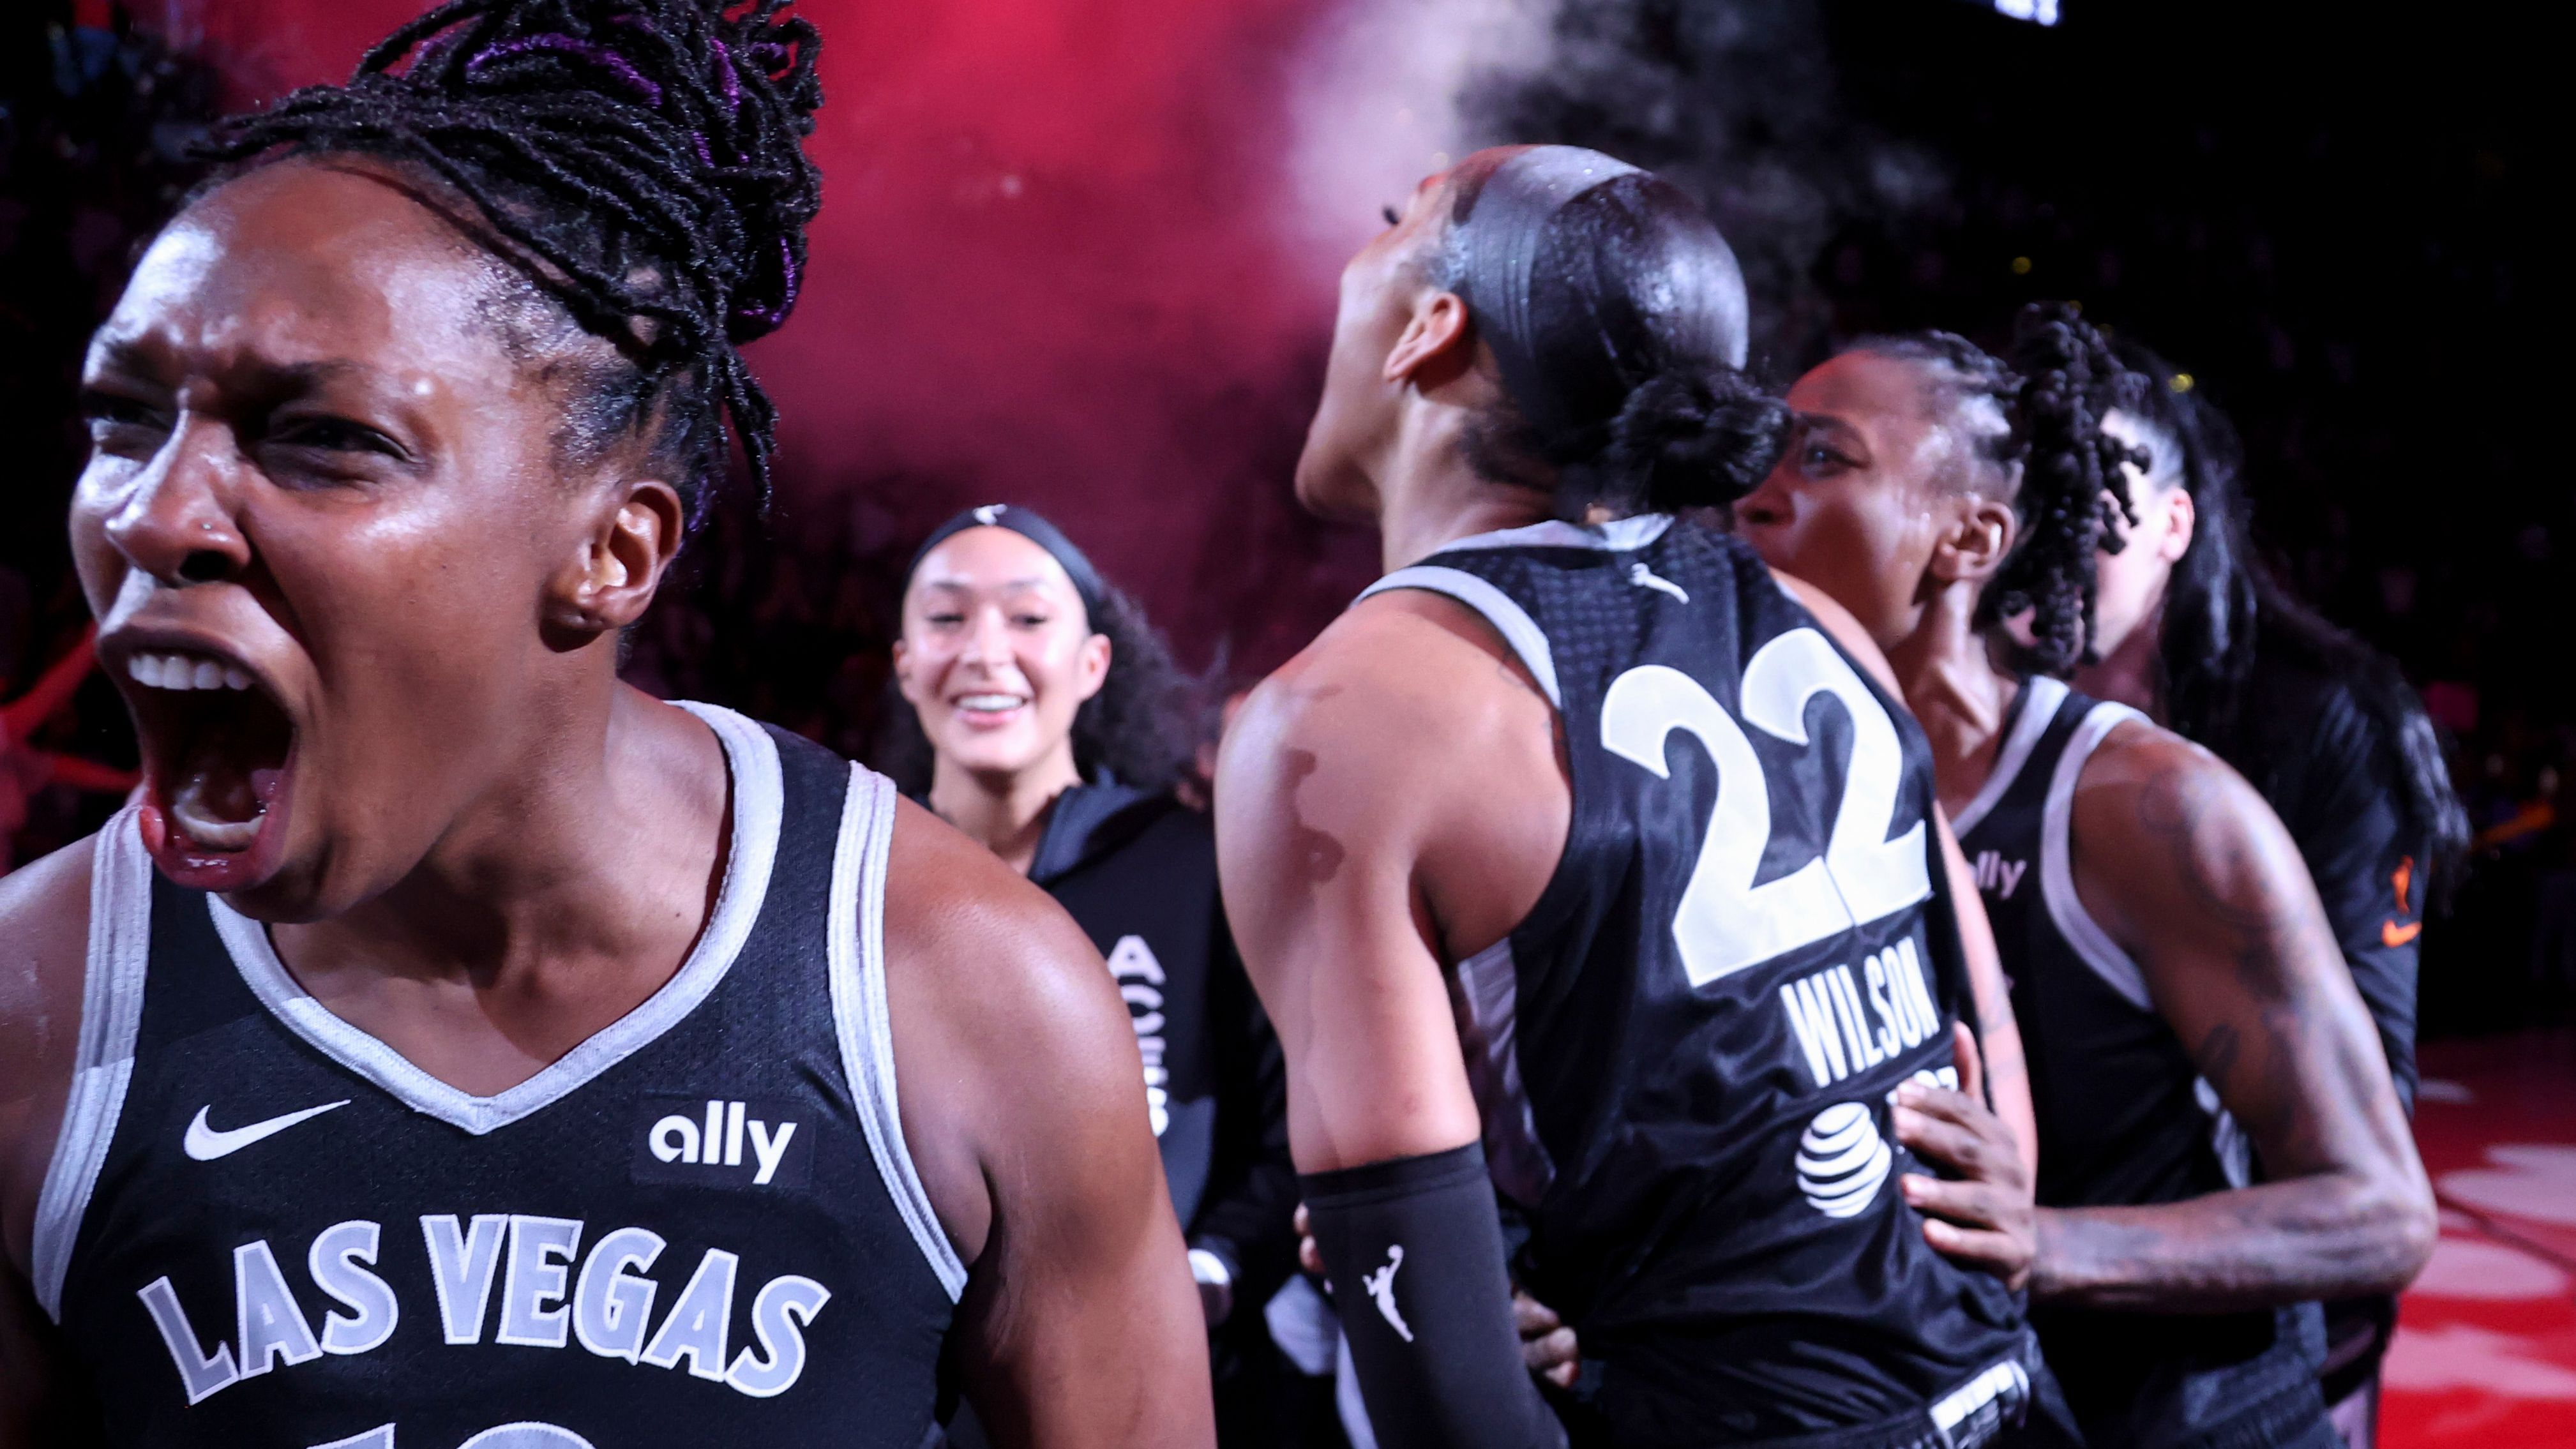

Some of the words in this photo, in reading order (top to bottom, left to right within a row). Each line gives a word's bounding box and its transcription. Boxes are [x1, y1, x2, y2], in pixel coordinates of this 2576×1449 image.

[1601, 627, 1932, 987] 22
[1780, 936, 1940, 1088] WILSON
[649, 1100, 797, 1185] ally
[137, 1220, 400, 1406] LAS
[419, 1214, 832, 1398] VEGAS
